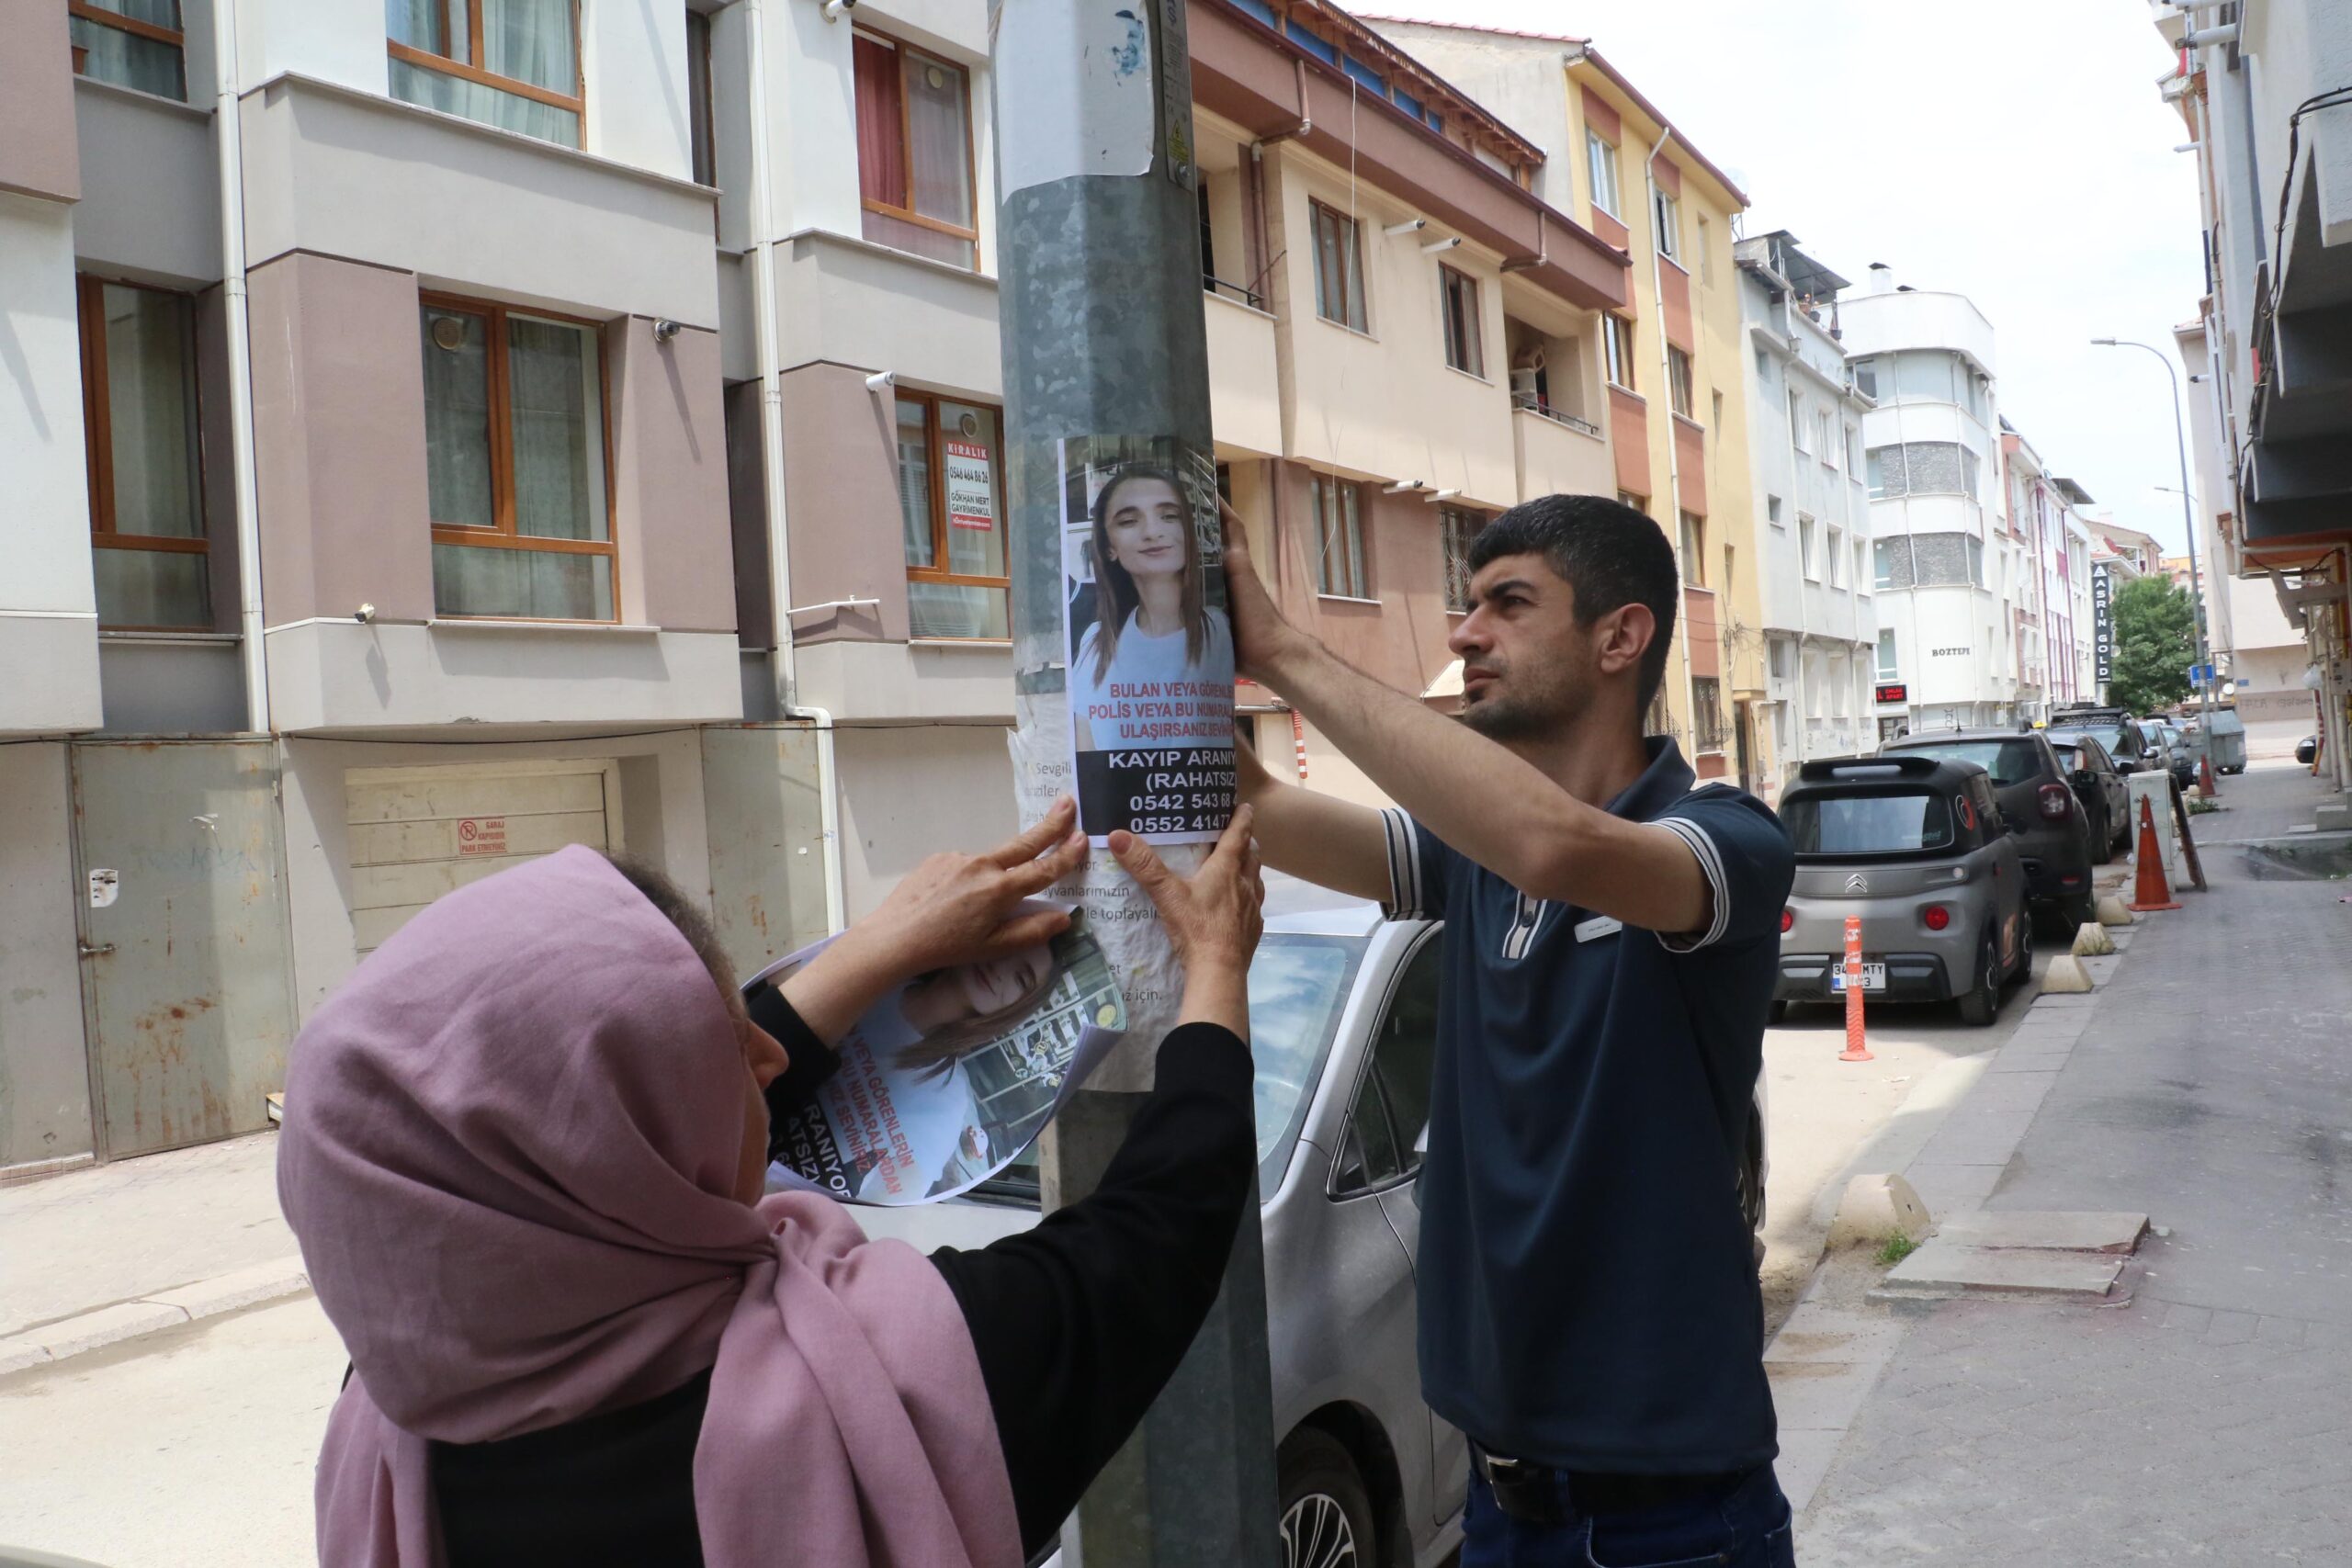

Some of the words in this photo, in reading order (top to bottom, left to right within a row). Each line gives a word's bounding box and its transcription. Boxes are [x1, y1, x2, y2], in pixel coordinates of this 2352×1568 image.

[2096, 580, 2107, 627] ASRIN
[2098, 634, 2109, 676] GOLD
[1110, 682, 1160, 699] BULAN
[1163, 682, 1198, 698] VEYA
[1089, 701, 1131, 719] POLİS
[1135, 703, 1172, 718] VEYA
[1175, 703, 1193, 717] BU
[1120, 722, 1207, 741] ULAŞIRSANIZ
[1108, 750, 1182, 769] KAYIP
[1036, 762, 1072, 777] Sevgili
[1129, 795, 1184, 811] 0542
[1192, 793, 1218, 809] 543
[1130, 816, 1185, 833] 0552
[1192, 814, 1219, 830] 414
[1042, 885, 1130, 898] ayvanlarımızın
[1101, 906, 1160, 922] toplayalı
[1862, 964, 1883, 975] MTY
[854, 1037, 877, 1077] VEYA
[868, 1076, 915, 1168] GÖRENLERİN
[805, 1103, 852, 1198] RANIYO
